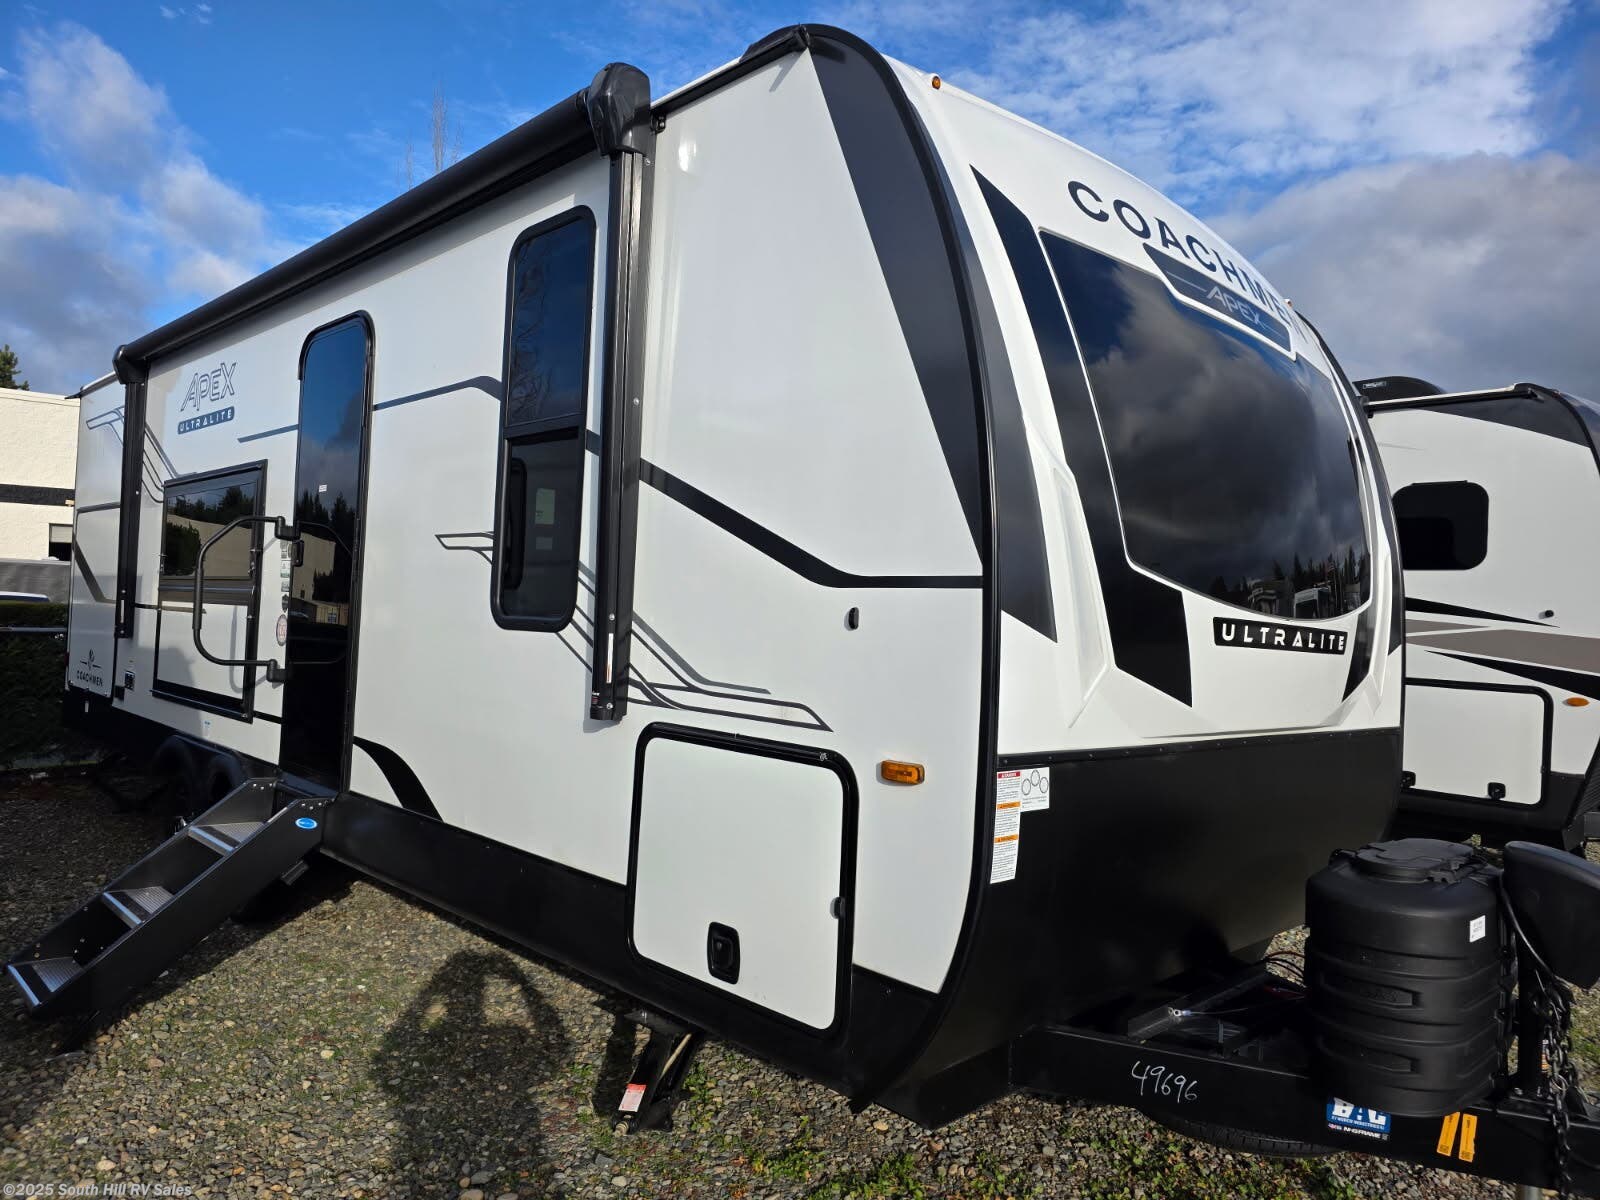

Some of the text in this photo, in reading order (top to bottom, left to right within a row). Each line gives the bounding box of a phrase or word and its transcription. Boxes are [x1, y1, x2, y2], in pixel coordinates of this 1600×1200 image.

[1206, 286, 1265, 329] APEX
[180, 362, 237, 411] APEX
[179, 409, 232, 432] ULTRALITE
[1222, 623, 1345, 651] ULTRALITE
[76, 670, 103, 687] COACHMEN
[1131, 1060, 1198, 1104] 49696
